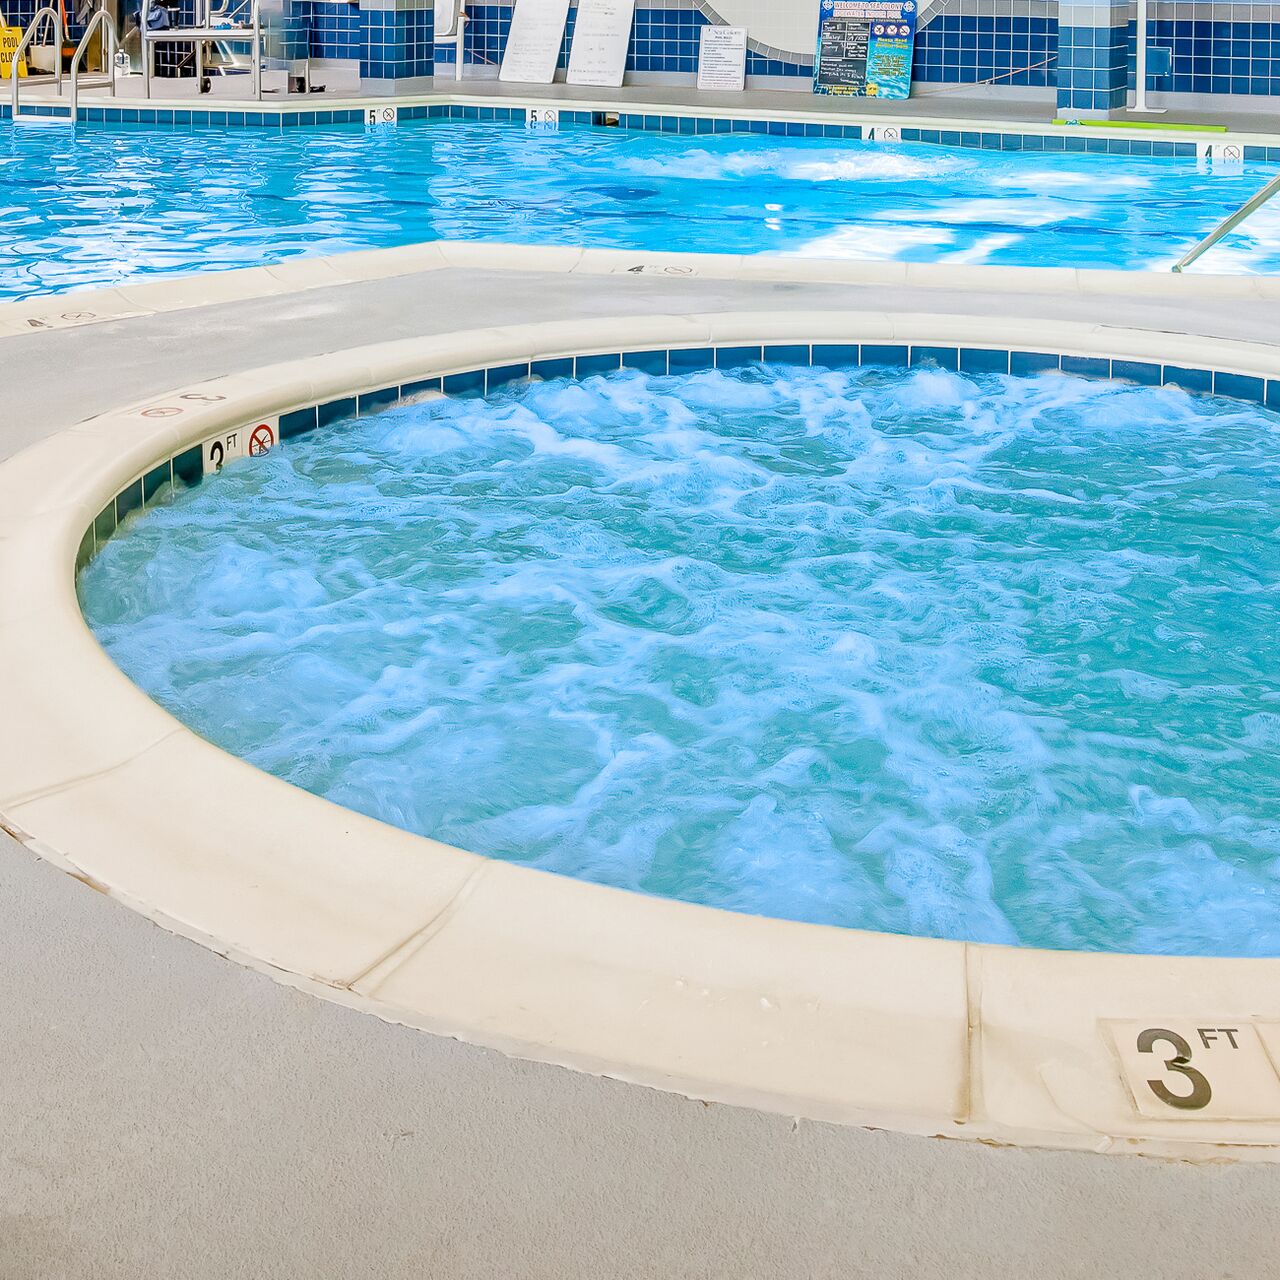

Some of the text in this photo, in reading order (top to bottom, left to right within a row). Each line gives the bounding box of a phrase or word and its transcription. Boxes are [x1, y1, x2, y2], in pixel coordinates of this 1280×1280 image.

[834, 1, 860, 10] WELCOME
[861, 2, 869, 10] TO
[881, 3, 903, 11] COLONY
[2, 37, 19, 48] POOL
[1, 51, 25, 63] CLOD
[370, 110, 376, 125] 5
[226, 433, 238, 451] FT
[1136, 1028, 1239, 1111] 3 FT
